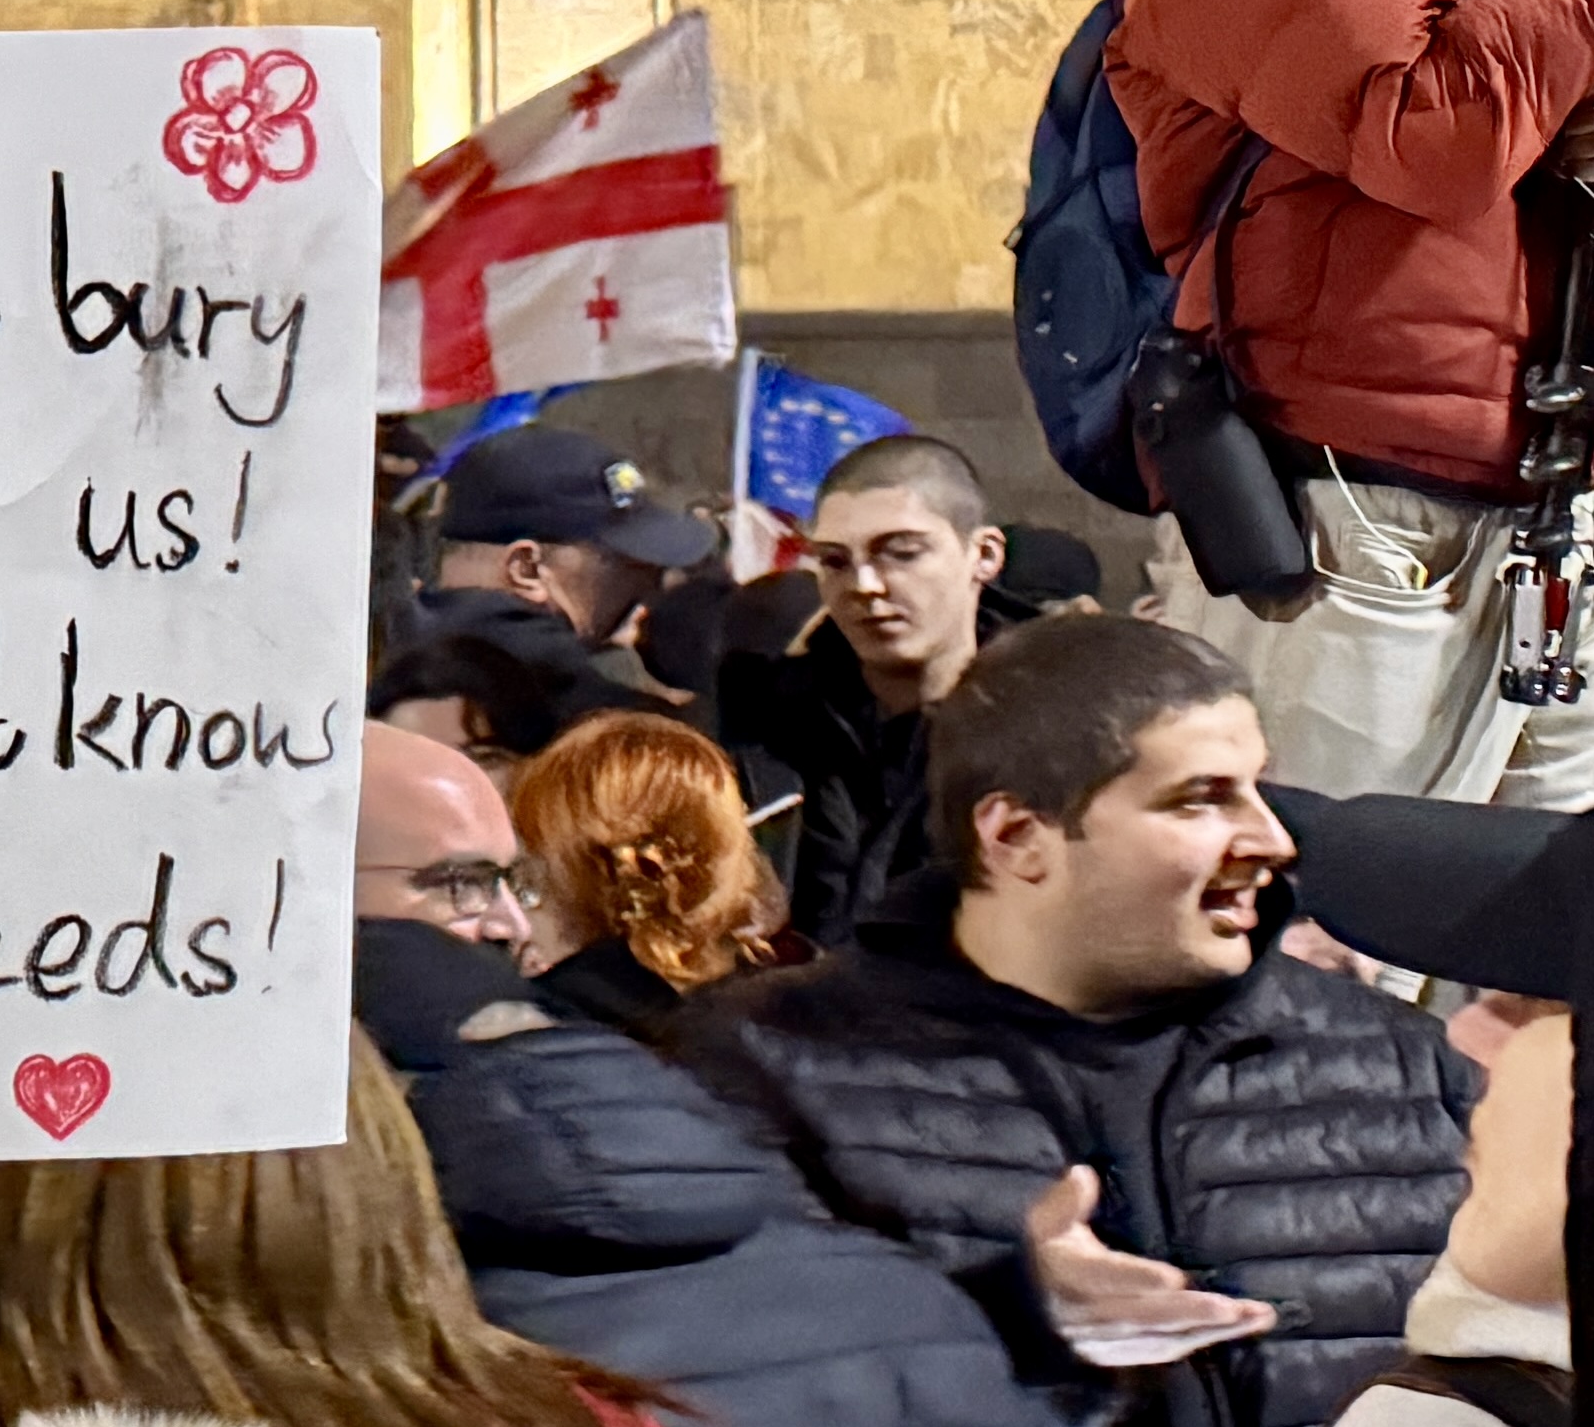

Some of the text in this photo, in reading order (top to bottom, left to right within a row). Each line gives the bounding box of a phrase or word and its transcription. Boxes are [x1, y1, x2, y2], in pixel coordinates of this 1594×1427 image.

[51, 170, 308, 429] bury
[75, 449, 253, 577] us!
[53, 617, 339, 772] know
